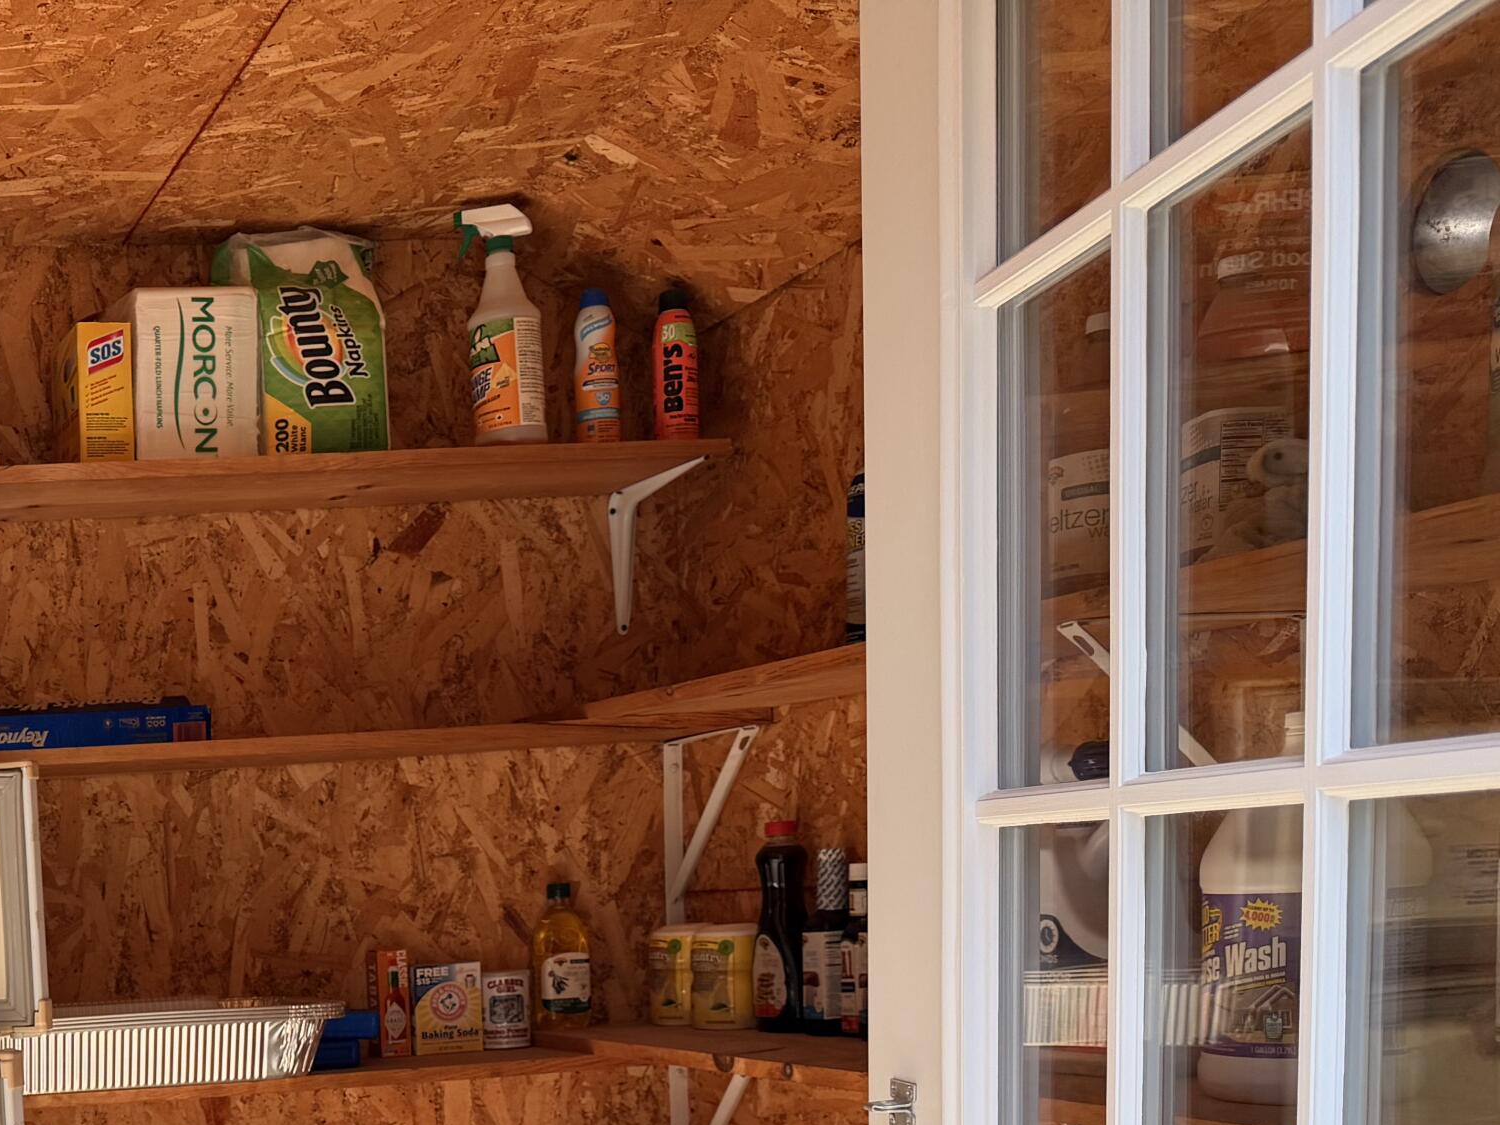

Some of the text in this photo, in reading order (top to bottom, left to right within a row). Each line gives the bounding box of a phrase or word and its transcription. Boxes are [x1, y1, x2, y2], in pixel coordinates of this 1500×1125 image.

[224, 325, 233, 347] More
[278, 286, 355, 407] Bounty
[330, 304, 369, 378] Napkins
[153, 325, 164, 429] QUARTER-FOLD LUNCH NAPKINS
[191, 296, 219, 454] MORCON
[664, 343, 684, 414] Ben's
[225, 381, 234, 402] More
[275, 418, 289, 453] 200
[290, 425, 299, 453] White
[299, 426, 308, 452] Blanc
[396, 949, 408, 988] CLASSIC
[415, 966, 449, 979] FREE
[1224, 936, 1287, 978] Wash
[487, 978, 524, 990] CLABBER
[496, 984, 517, 994] GIRL
[421, 1025, 479, 1040] Baking Soda
